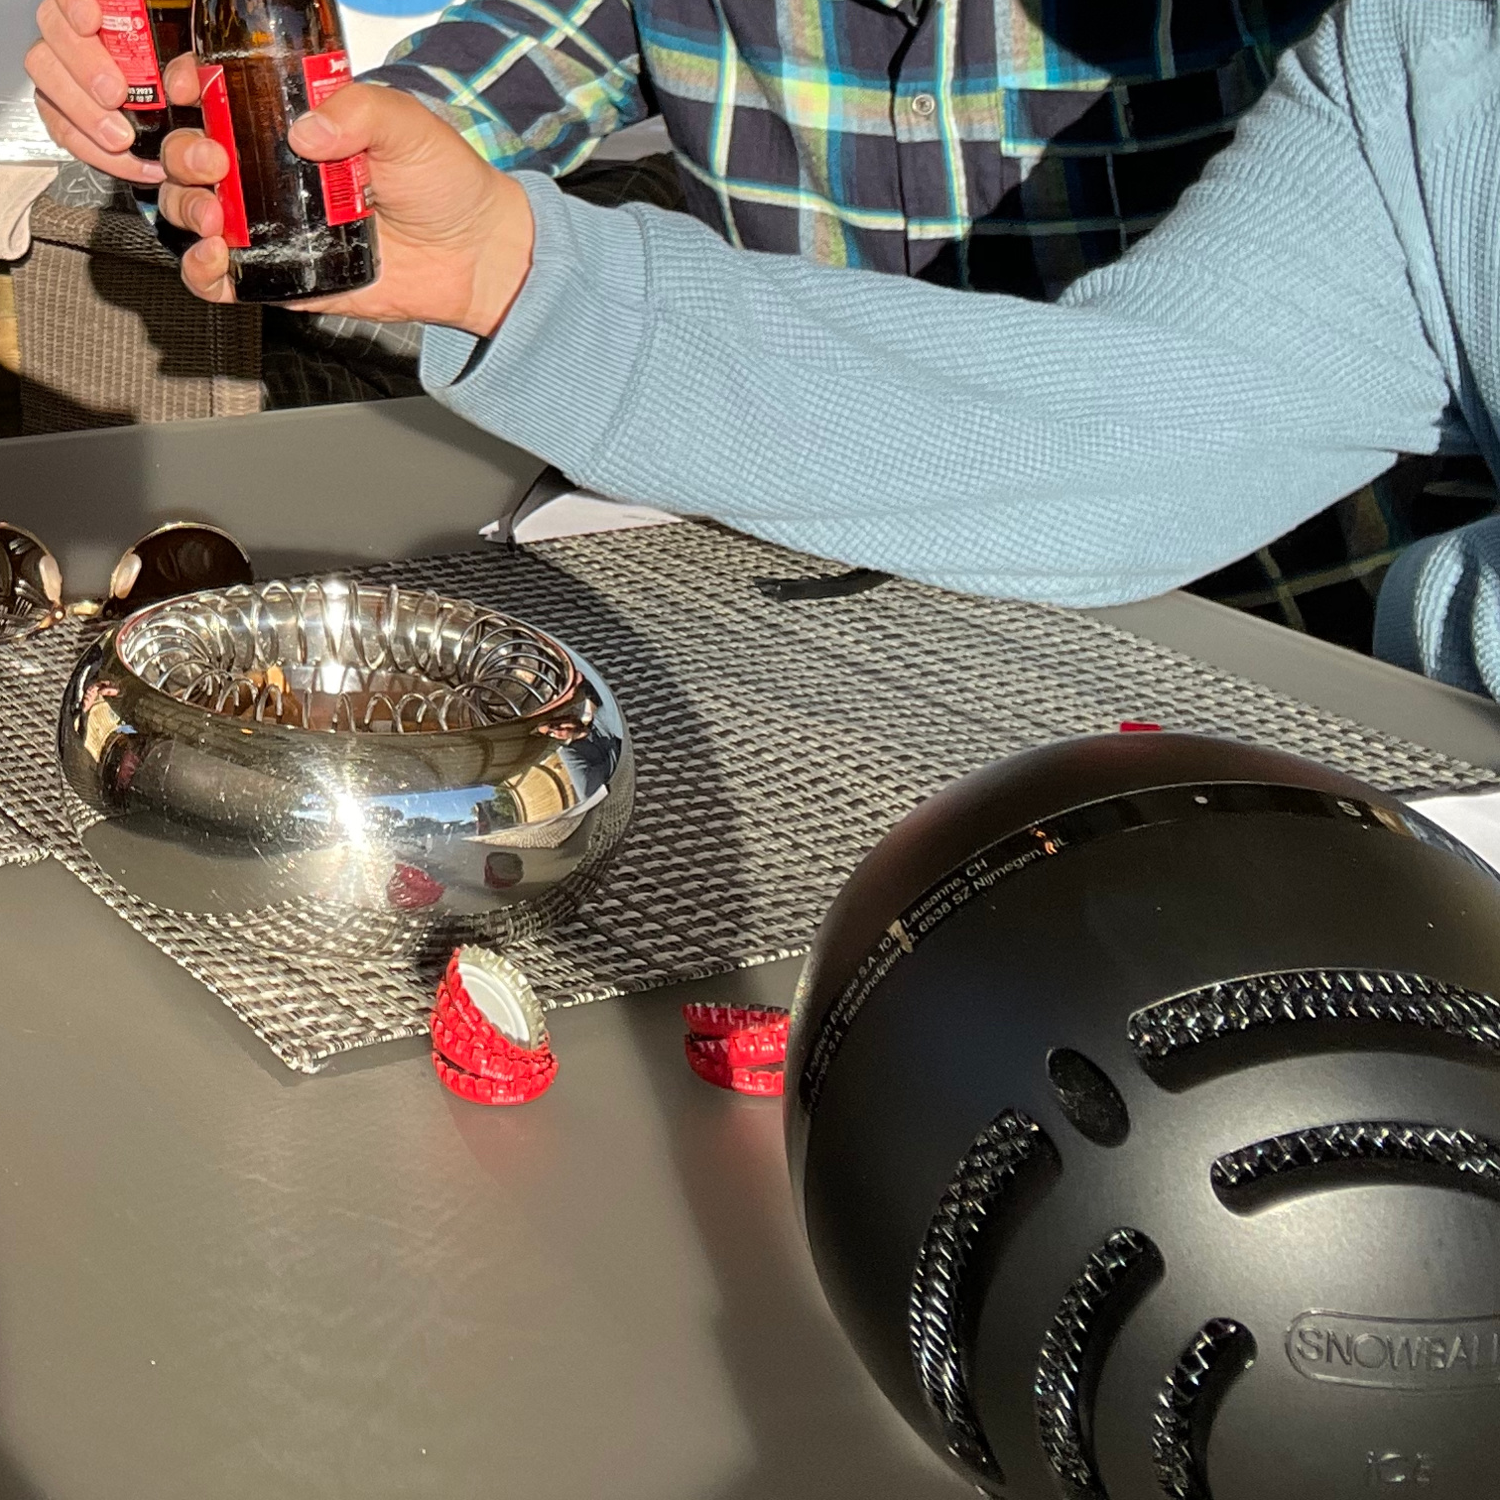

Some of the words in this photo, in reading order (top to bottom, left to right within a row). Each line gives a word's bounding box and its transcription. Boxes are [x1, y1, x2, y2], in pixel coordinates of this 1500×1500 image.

[965, 856, 989, 878] CH
[918, 901, 953, 934] 6538
[951, 884, 975, 906] SZ
